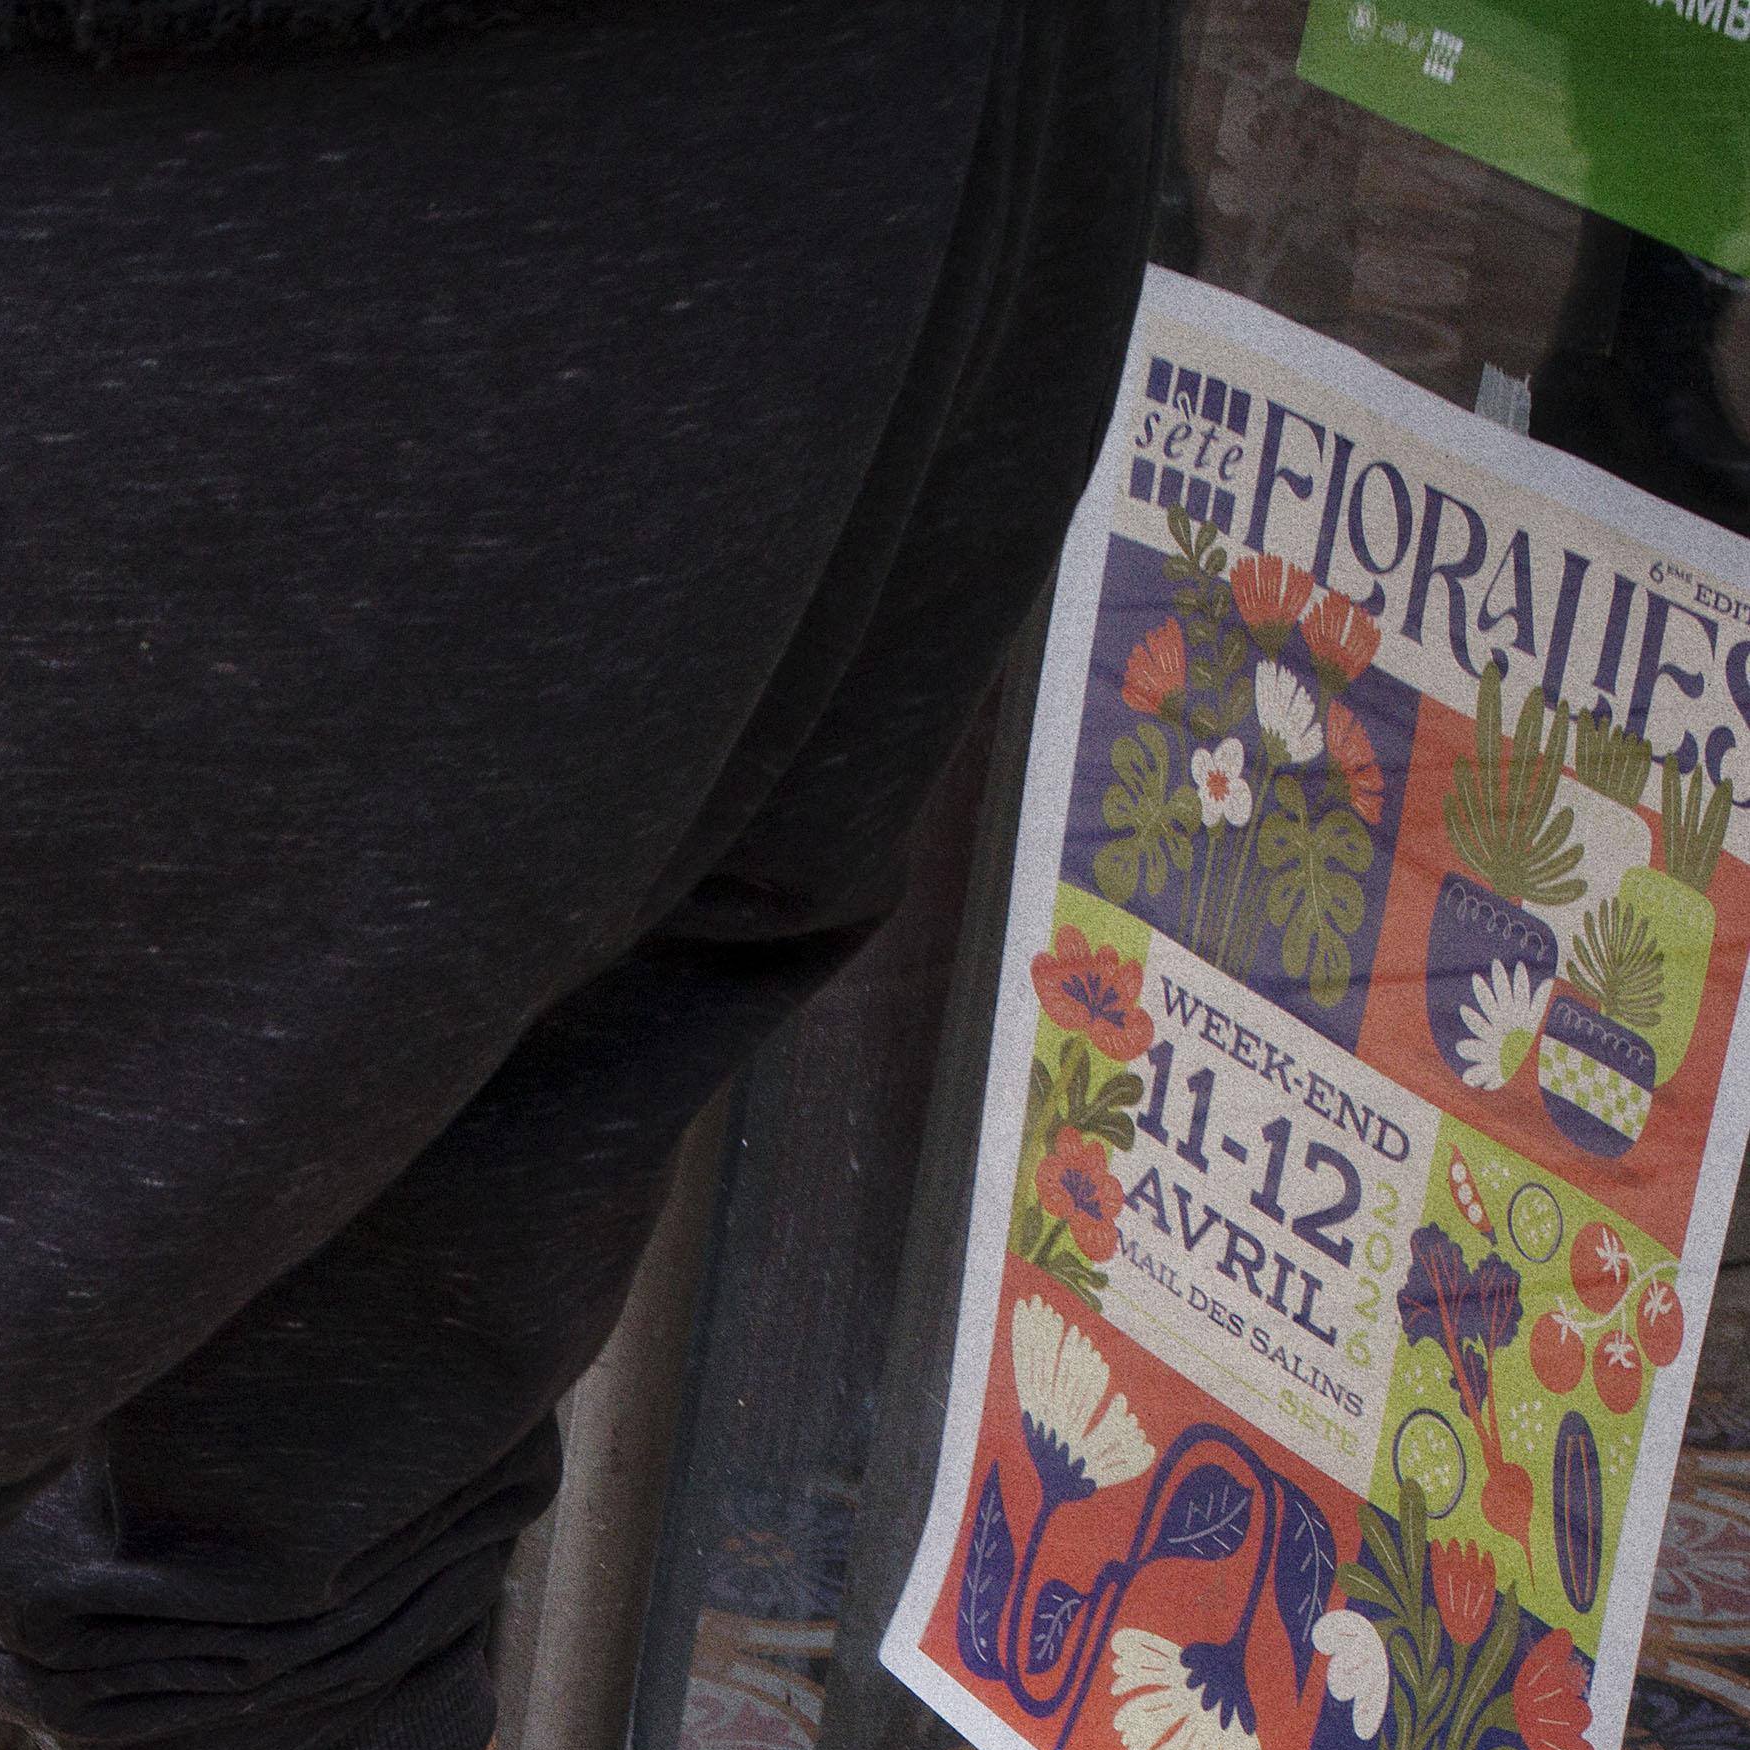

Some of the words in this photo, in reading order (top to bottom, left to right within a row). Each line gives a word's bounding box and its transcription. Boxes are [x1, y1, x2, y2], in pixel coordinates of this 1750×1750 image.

[1136, 1039, 1362, 1268] 11-12
[1161, 975, 1411, 1163] WEEK-END
[1116, 1227, 1182, 1297] MAIL
[1187, 1285, 1245, 1338] DES
[1250, 1326, 1364, 1417] SALINS
[1125, 1167, 1338, 1348] AVRIL
[1346, 1181, 1400, 1367] 2026
